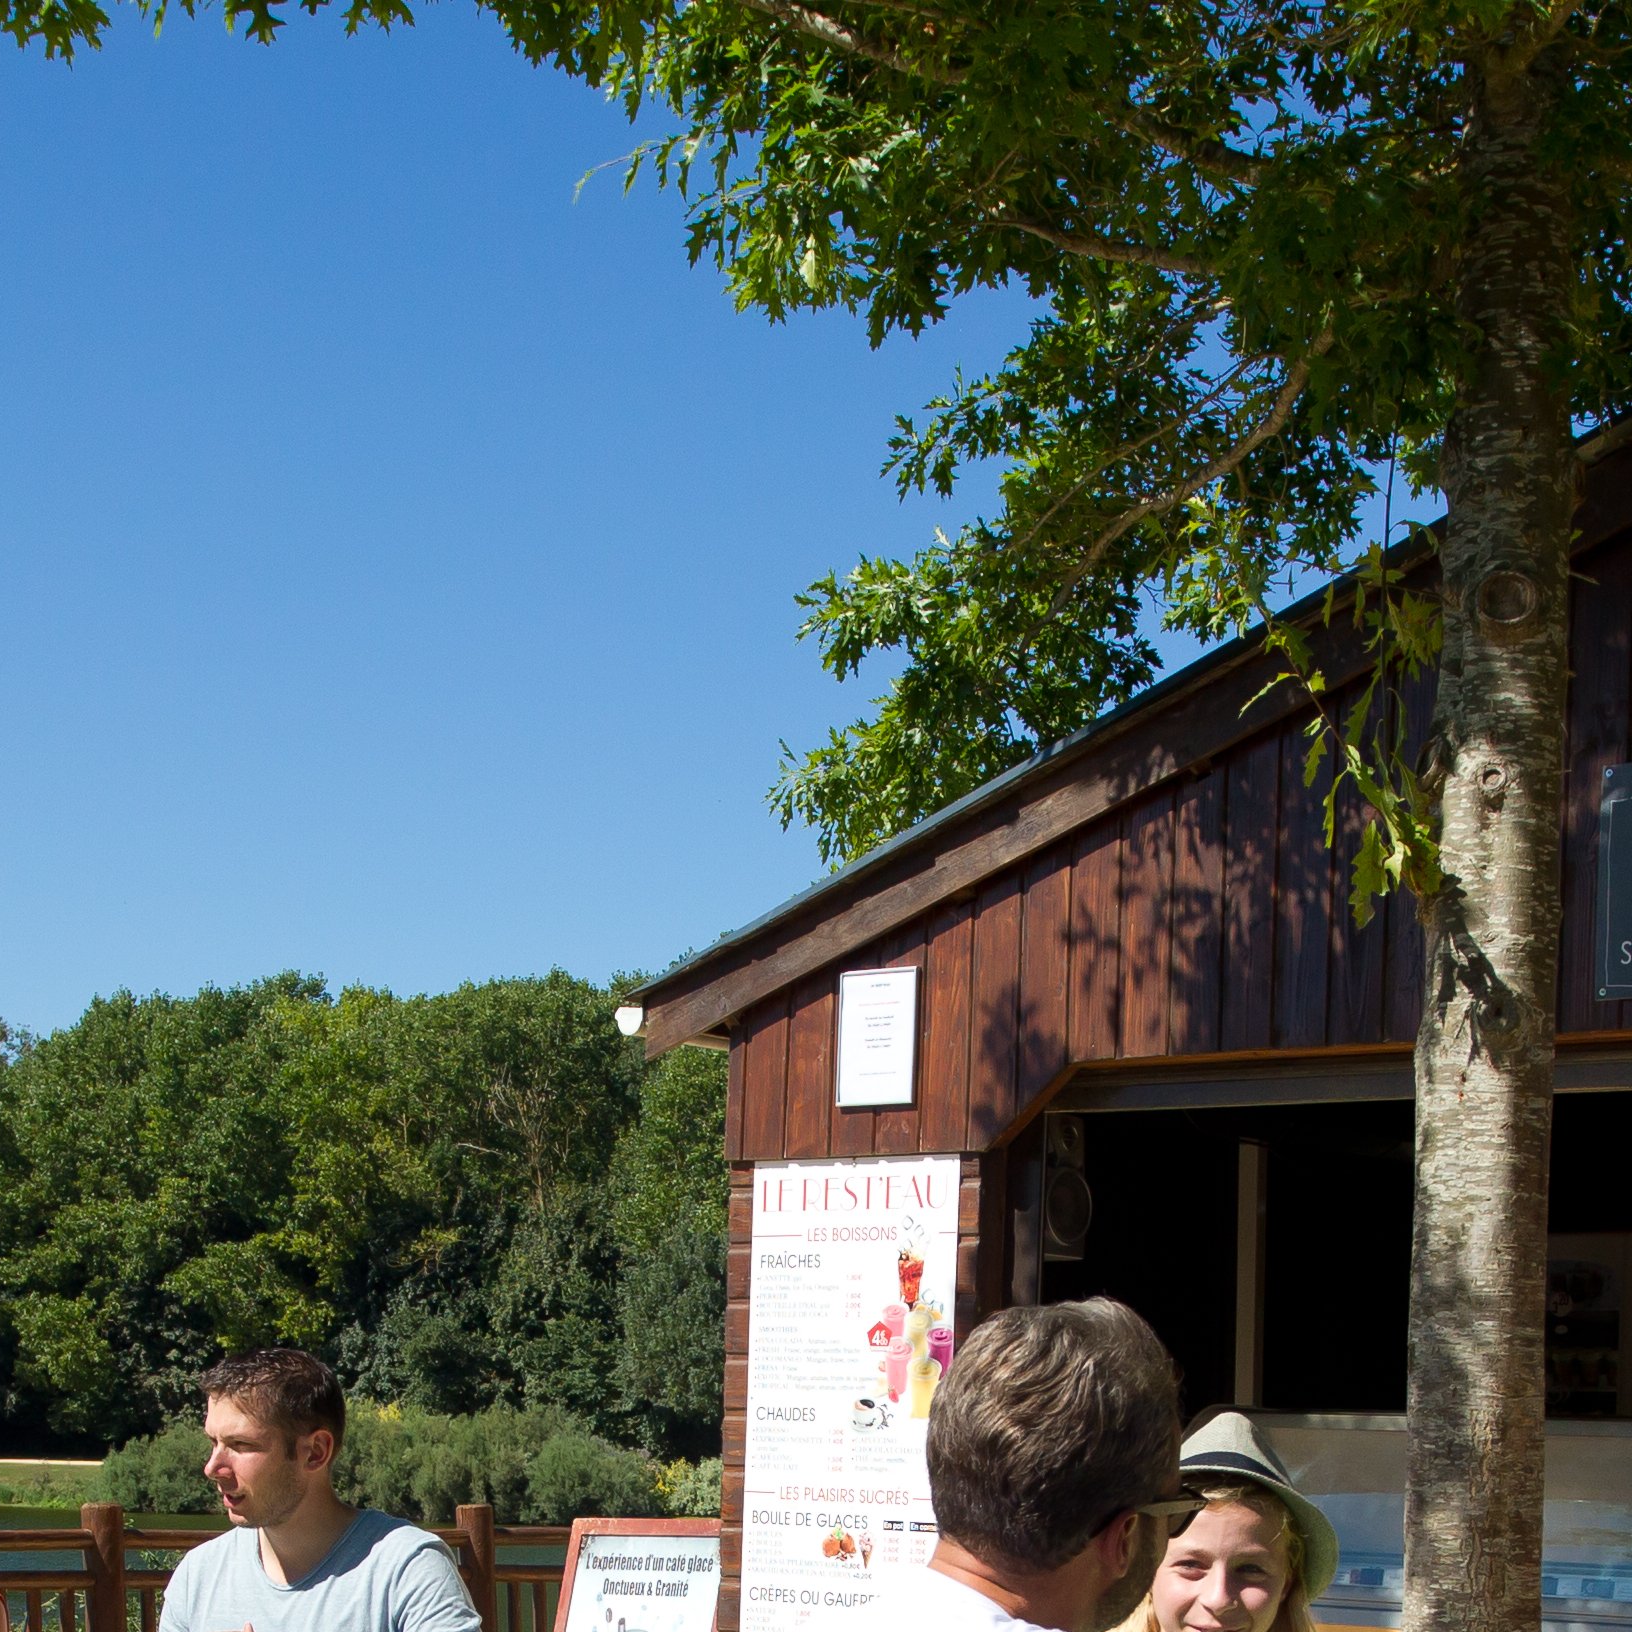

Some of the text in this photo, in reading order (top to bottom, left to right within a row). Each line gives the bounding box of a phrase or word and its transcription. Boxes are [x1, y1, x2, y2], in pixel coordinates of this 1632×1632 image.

[762, 1175, 949, 1212] LE REST'EAU
[807, 1226, 898, 1242] LES BOISSONS
[760, 1250, 821, 1269] FRAÎCHES
[756, 1406, 816, 1422] CHAUDES
[780, 1486, 909, 1505] LES PLAISIRS SUCRÉS
[752, 1510, 868, 1529] BOULE DE GLACES
[586, 1553, 714, 1574] L'expérience d'un café glacé
[603, 1578, 689, 1597] Onctueux & Granité
[749, 1583, 796, 1604] CRÊPES
[800, 1590, 819, 1605] OU
